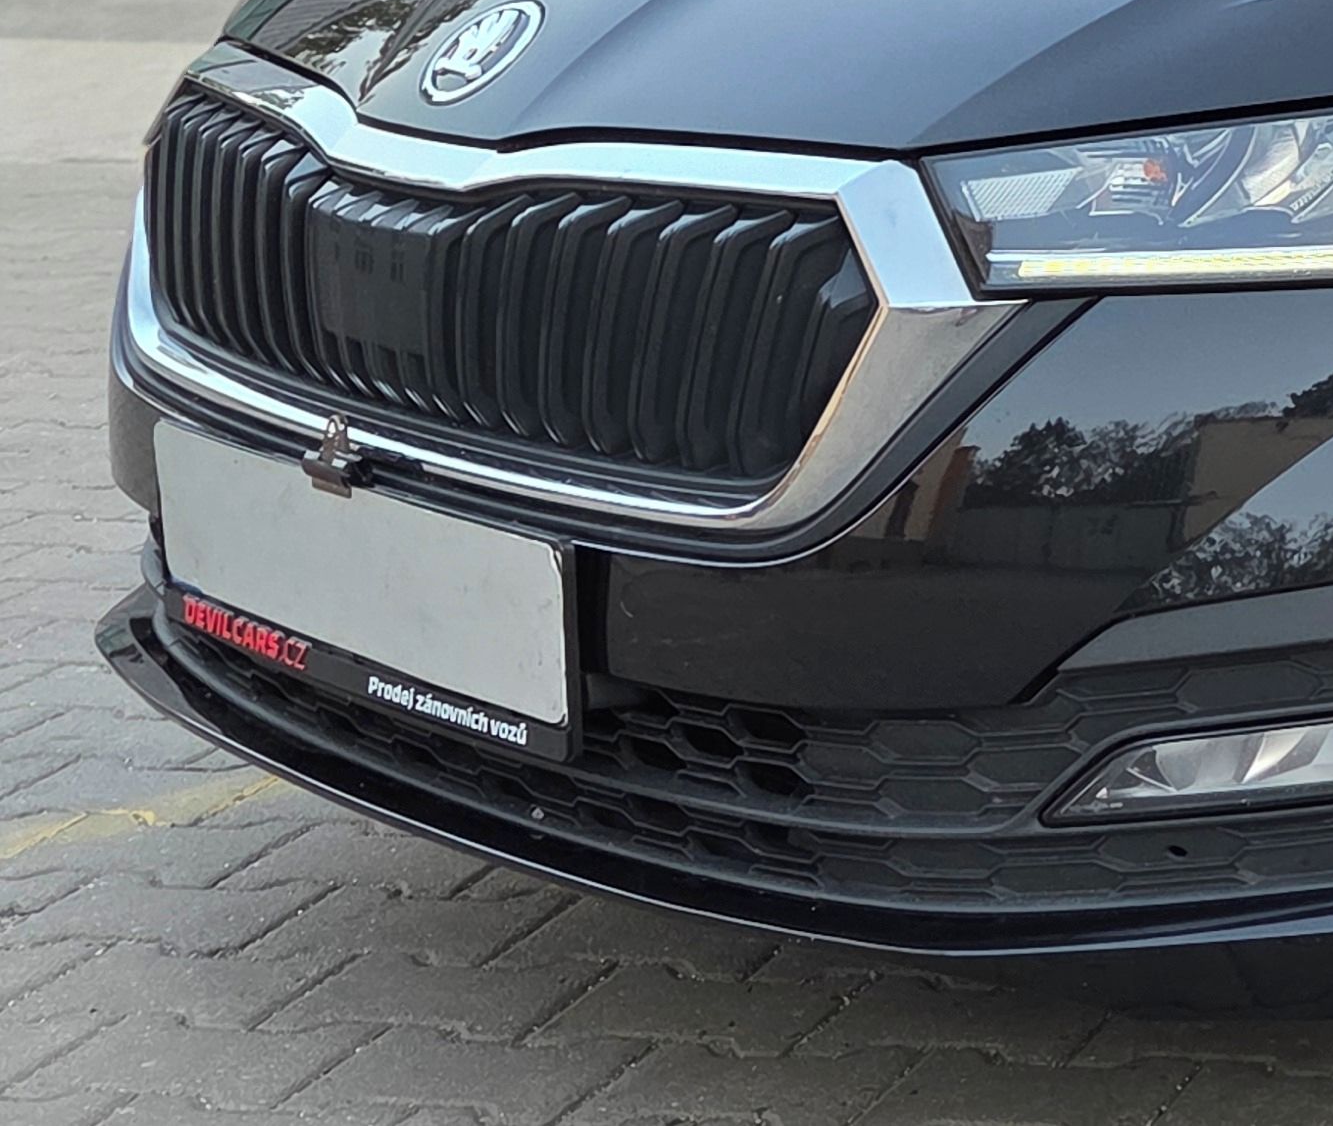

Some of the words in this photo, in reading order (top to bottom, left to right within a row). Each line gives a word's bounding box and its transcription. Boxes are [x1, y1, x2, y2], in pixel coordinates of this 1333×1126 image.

[367, 676, 415, 711] Prodej
[415, 693, 488, 735] zánovních
[490, 722, 527, 746] vozů
